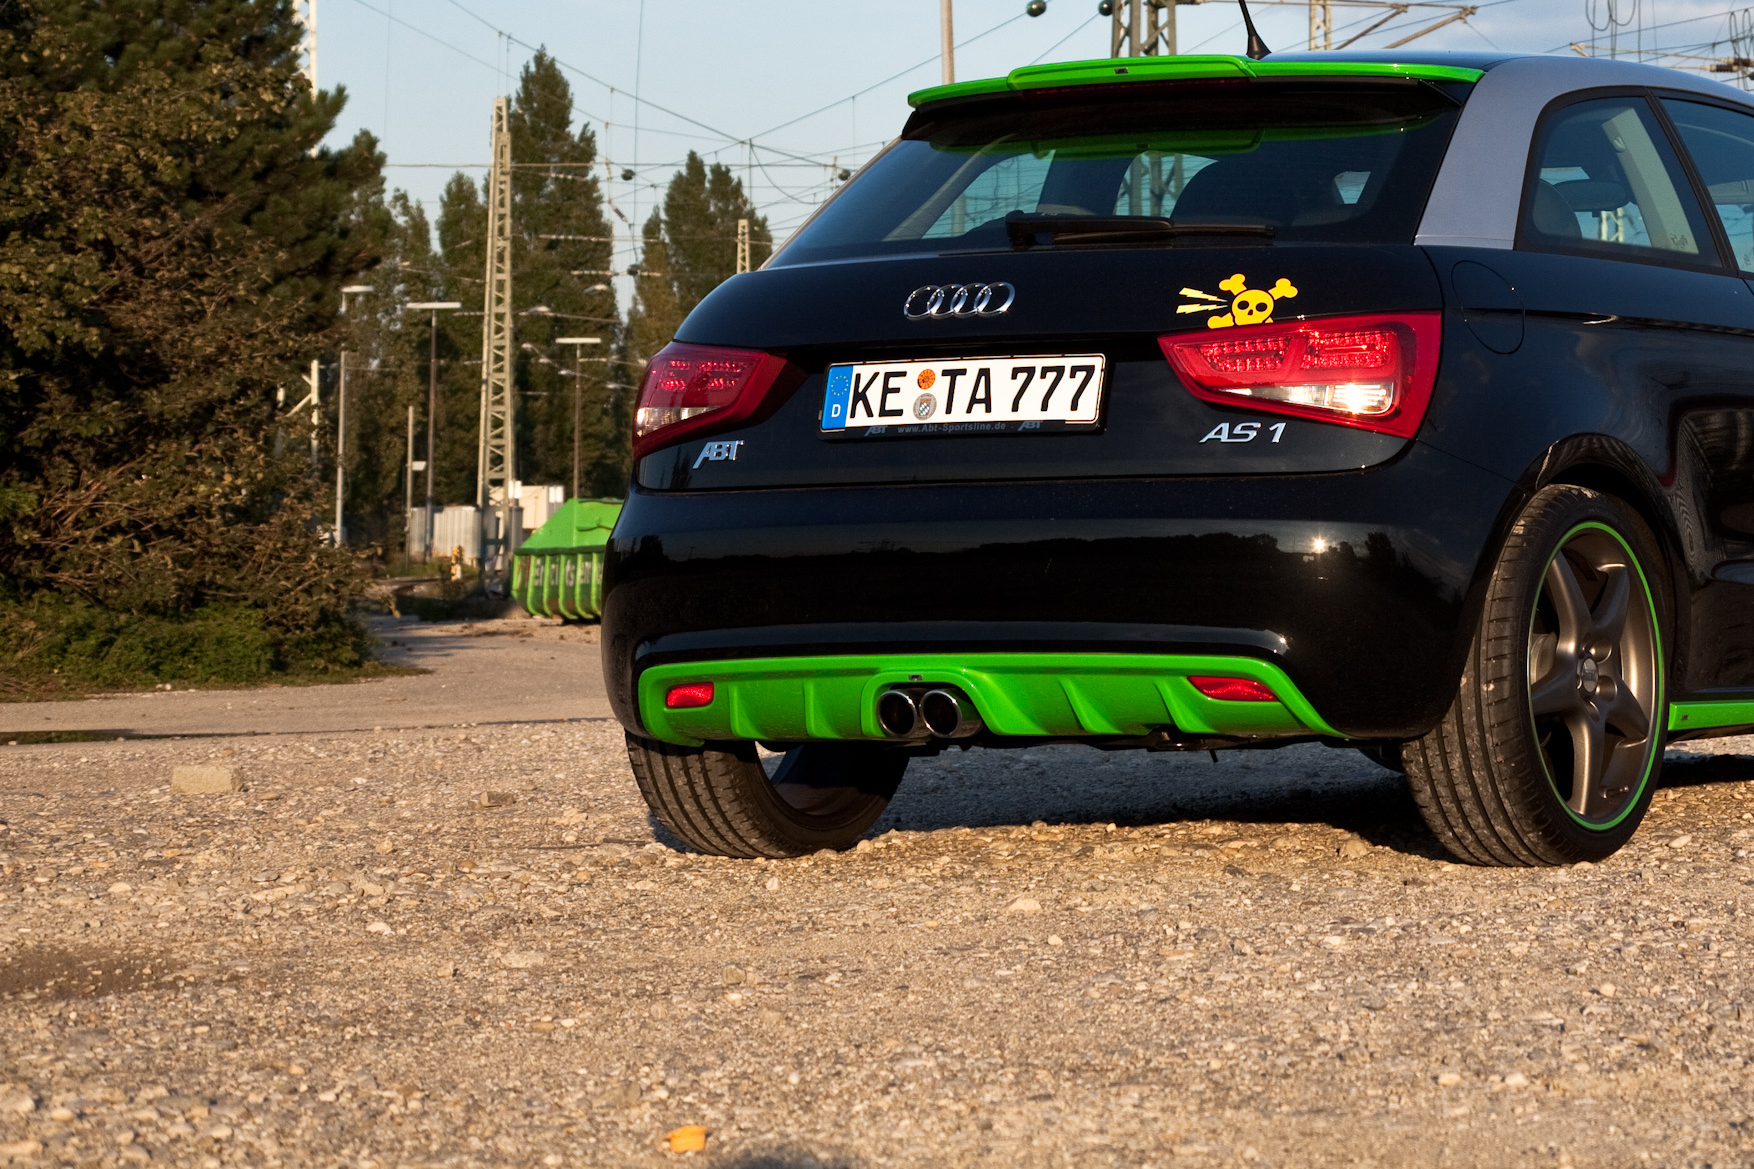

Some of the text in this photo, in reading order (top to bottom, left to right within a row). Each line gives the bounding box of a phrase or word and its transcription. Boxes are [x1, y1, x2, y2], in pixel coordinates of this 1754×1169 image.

[849, 371, 908, 419] KE
[941, 367, 992, 415] TA
[1011, 364, 1096, 413] 777
[831, 403, 841, 418] D
[1268, 422, 1287, 443] 1
[692, 440, 744, 469] ABT
